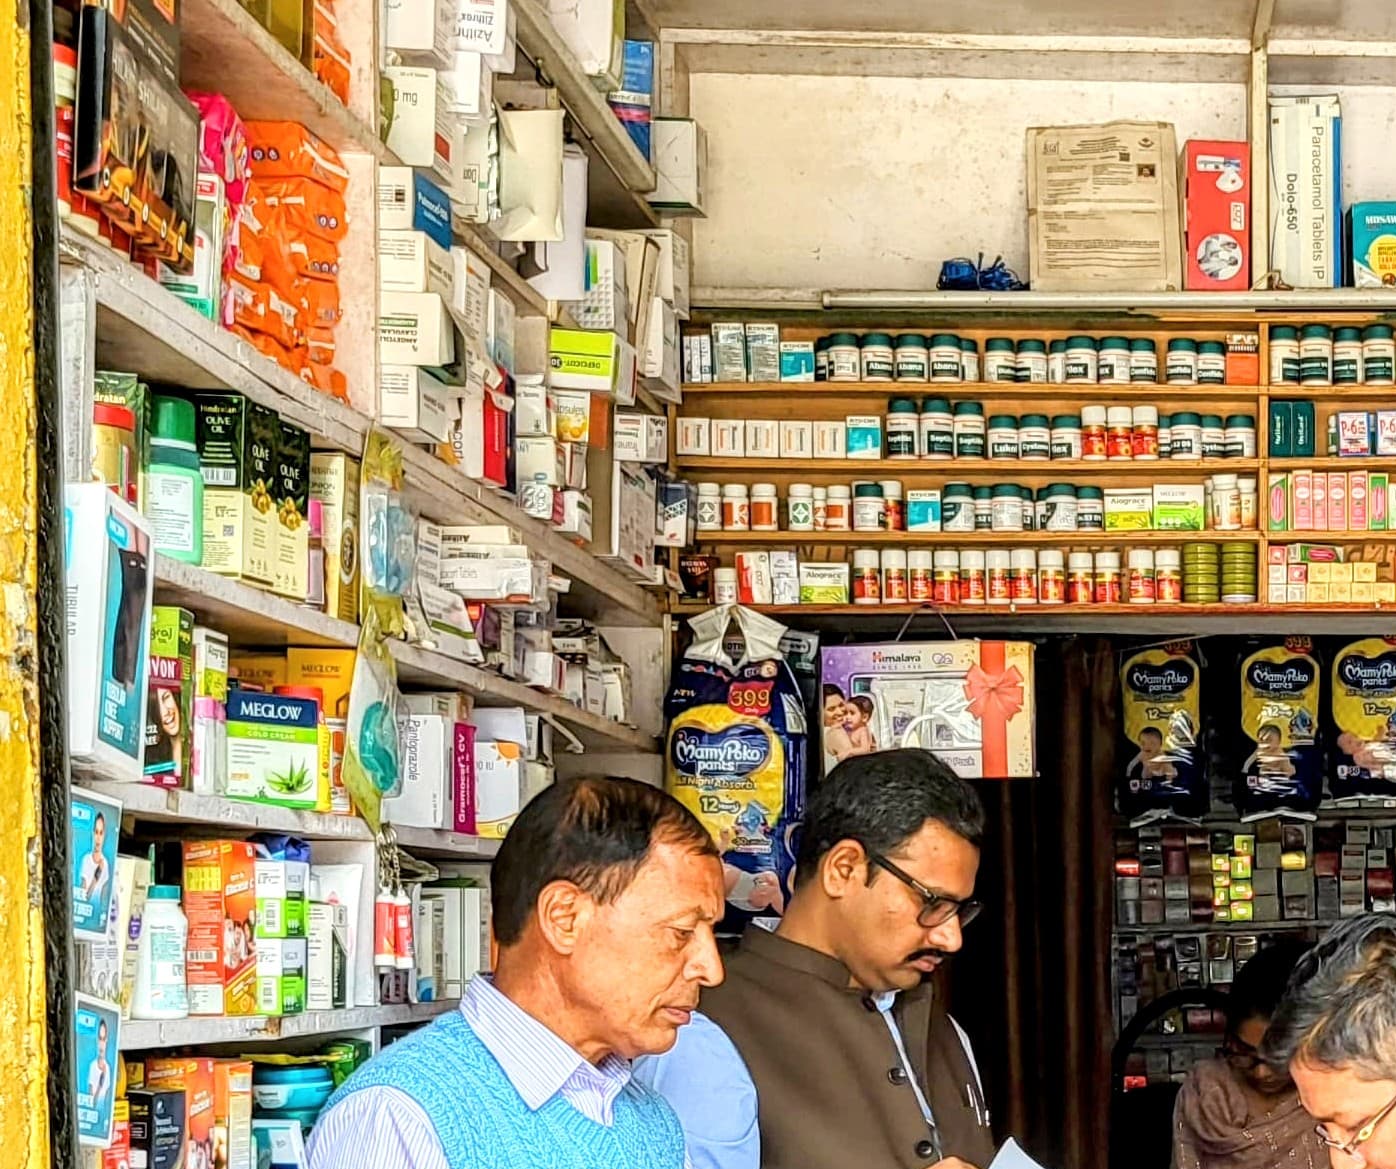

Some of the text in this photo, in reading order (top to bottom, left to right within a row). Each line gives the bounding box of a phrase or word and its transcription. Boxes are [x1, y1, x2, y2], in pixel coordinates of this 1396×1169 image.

[1311, 126, 1325, 280] Paracetamol Tablets IP
[205, 415, 232, 427] OLIVE
[211, 424, 225, 434] OIL
[252, 443, 270, 461] OLIVE
[255, 459, 266, 473] OIL
[280, 463, 300, 481] OLIVE
[284, 478, 296, 492] OIL
[871, 651, 922, 664] Himalaya
[301, 662, 341, 674] MEGLOW
[1132, 670, 1188, 686] MamyPoko
[1253, 668, 1309, 685] MamyPoko
[1362, 676, 1388, 687] pants
[1148, 682, 1173, 693] pants
[1268, 680, 1293, 691] pants
[730, 688, 770, 708] 399
[239, 702, 303, 721] MEGLOW
[409, 719, 421, 782] Pantoprazole
[676, 734, 763, 766] MamyPoko
[696, 759, 736, 773] pants
